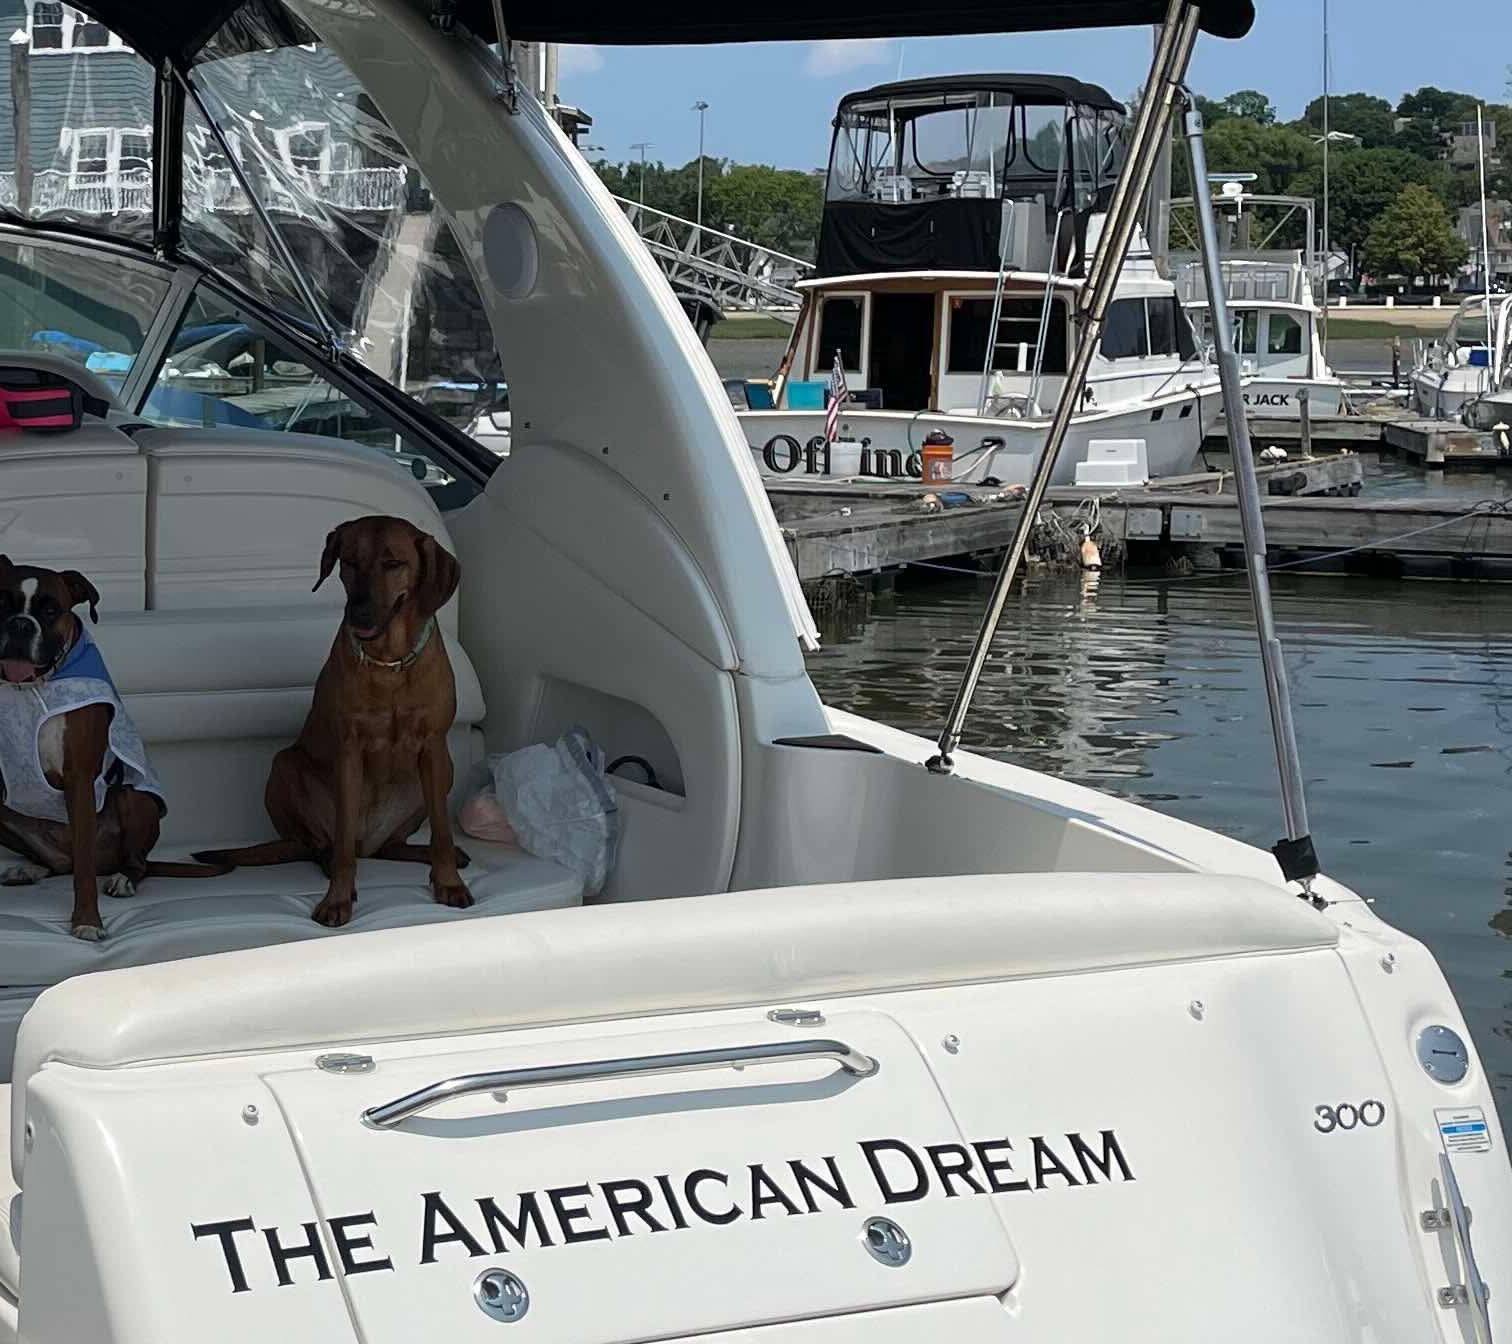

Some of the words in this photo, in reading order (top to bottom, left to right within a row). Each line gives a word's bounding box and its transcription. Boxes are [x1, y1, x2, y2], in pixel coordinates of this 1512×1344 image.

[1253, 394, 1290, 406] JACK
[1313, 1099, 1386, 1134] 300
[191, 1211, 395, 1293] THE
[418, 1156, 858, 1265] AMERICAN
[858, 1130, 1136, 1206] DREAM
